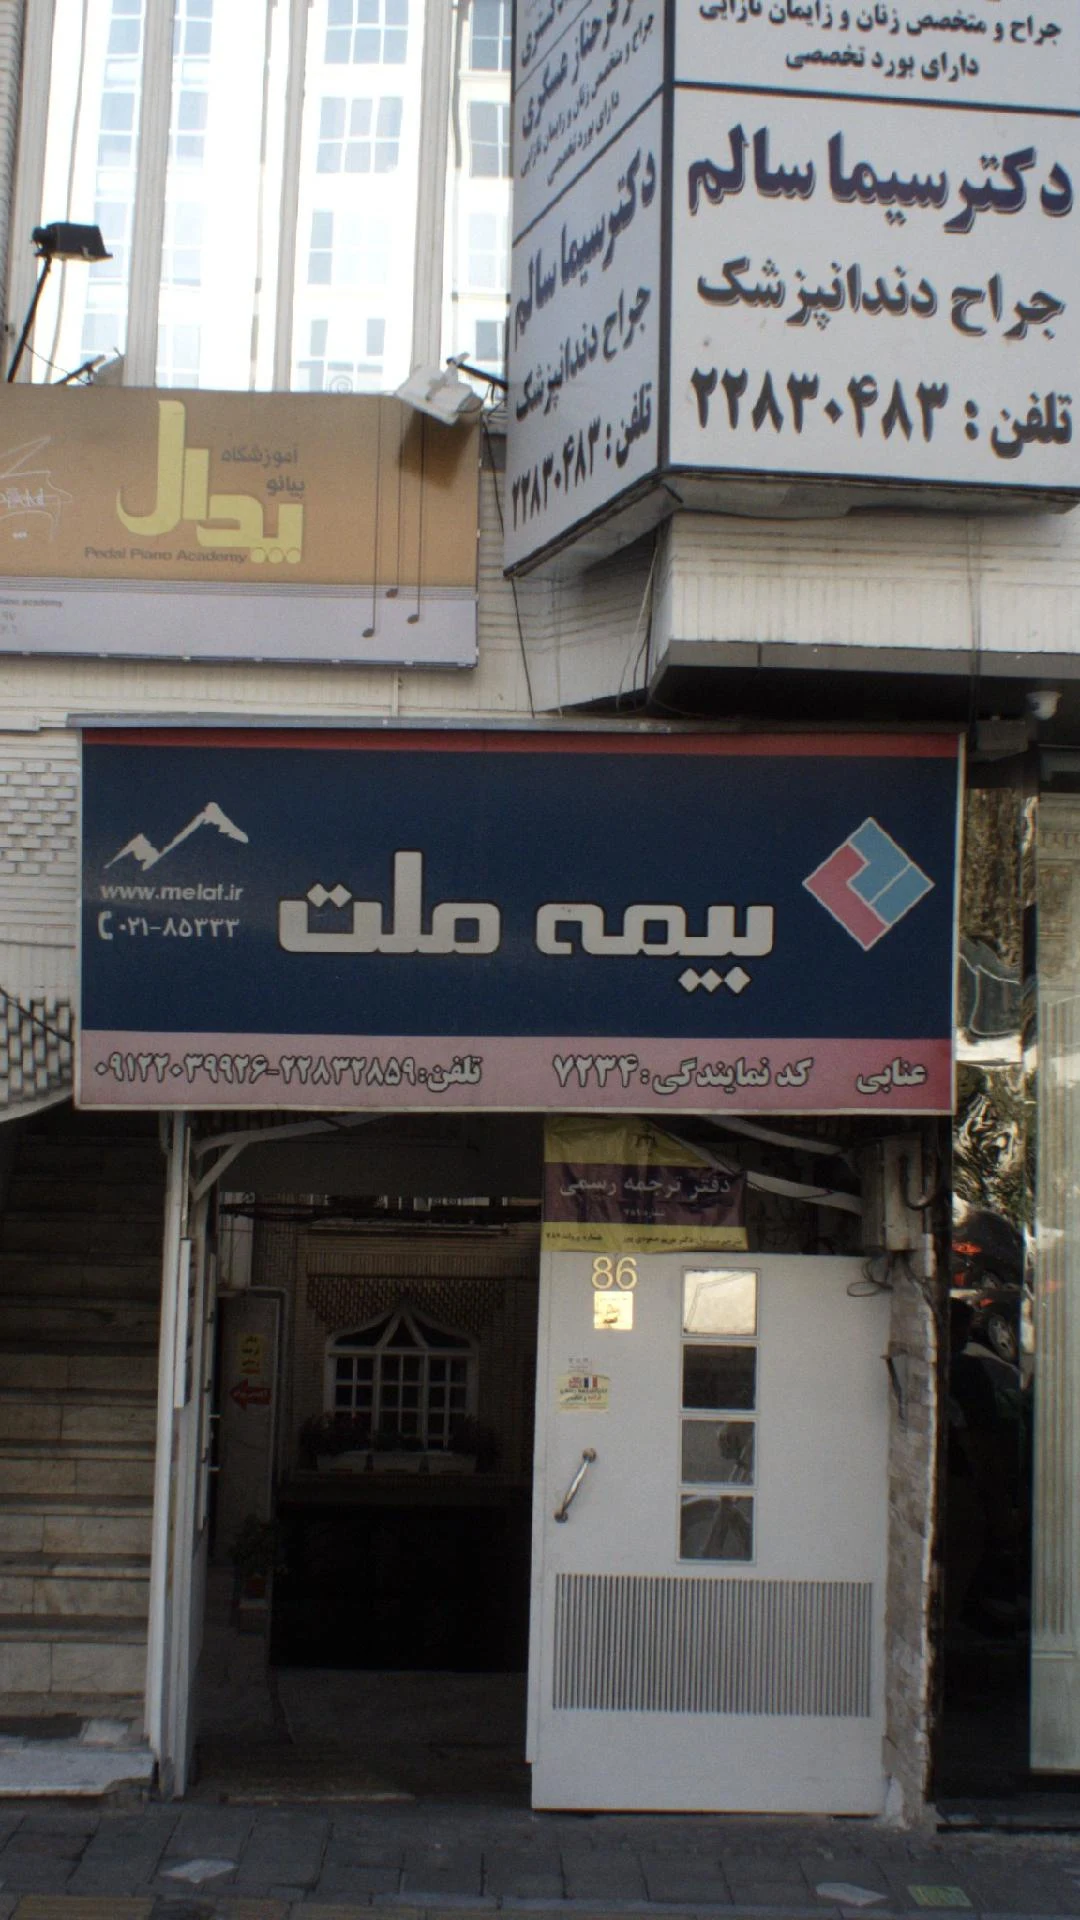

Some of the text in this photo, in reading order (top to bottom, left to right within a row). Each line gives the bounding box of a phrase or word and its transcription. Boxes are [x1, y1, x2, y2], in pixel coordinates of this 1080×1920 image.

[768, 0, 833, 30] زایمان
[838, 8, 850, 31] و
[856, 3, 900, 35] زنان
[906, 9, 988, 36] متخصص
[1008, 15, 1062, 46] جراح
[992, 21, 1005, 43] و
[786, 45, 980, 83] دارای بورد تخصصی
[687, 123, 1074, 234] دکتر سیما سالم
[515, 147, 656, 354] دکتر سیما سالم
[697, 256, 1067, 341] جراح دندانپزشک
[515, 285, 652, 423] جراح دندانپزشک
[690, 366, 950, 443] ۲۲۸۳۰۴۸۳
[266, 475, 306, 500] پیانو
[511, 415, 601, 532] ۲۲۸۳۰۴۸۳
[84, 547, 248, 564] Pedal Piano Academy
[100, 884, 244, 902] www.melat.ir
[278, 850, 775, 994] بیمه ملت
[552, 1054, 640, 1088] ۷۲۳۴
[775, 1056, 814, 1088] کد
[855, 1057, 928, 1094] عنابی
[559, 1175, 731, 1200] دفتر ترجمه رسمی
[591, 1256, 637, 1290] 86
